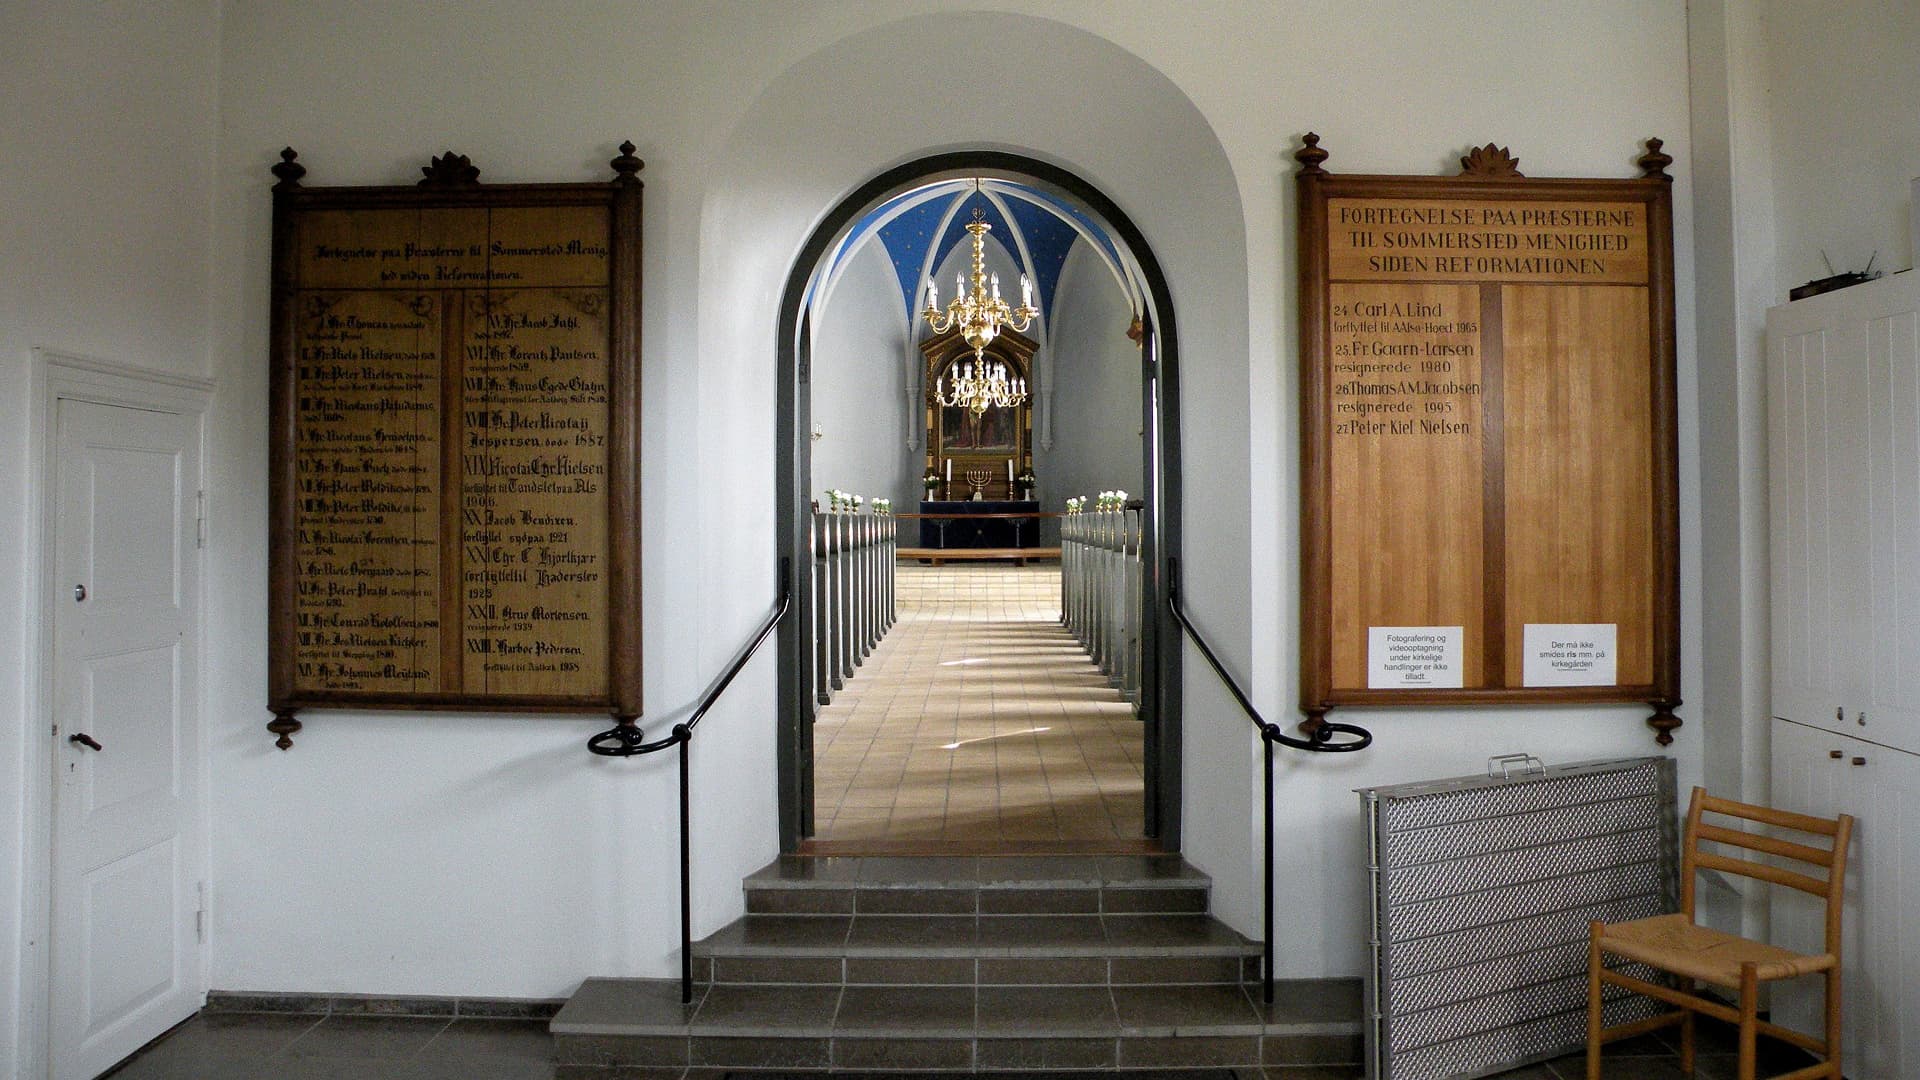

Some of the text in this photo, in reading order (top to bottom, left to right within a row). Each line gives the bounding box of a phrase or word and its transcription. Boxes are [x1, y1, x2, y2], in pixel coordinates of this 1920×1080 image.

[1340, 207, 1635, 228] FORTEGNELSE PAA PRÆSTERNE
[491, 241, 564, 257] Sommersted
[1348, 231, 1629, 251] TIL SOMMERSTED MENIGHED
[1368, 255, 1607, 274] SIDEN REFORMATIONEN
[1354, 301, 1387, 318] Carl
[1406, 301, 1442, 318] Lind
[1333, 321, 1378, 338] forflyttet
[1380, 321, 1390, 333] til
[1455, 321, 1478, 334] 1965
[1371, 341, 1474, 357] Gaarn-Larsen
[1334, 360, 1452, 377] resignerede 1980
[1349, 380, 1397, 396] Thomas
[1421, 380, 1481, 396] Jacobsen
[1336, 400, 1453, 418] resignerede 1995
[1350, 419, 1387, 436] Peter
[1390, 419, 1415, 436] Kiel
[1419, 419, 1471, 436] Nielsen
[548, 531, 569, 544] 1921
[535, 568, 599, 587] Haderslev
[1386, 634, 1447, 644] Fotografering og
[1551, 640, 1594, 649] Der må ikke
[1388, 644, 1445, 653] videooptagning
[1595, 650, 1605, 659] på
[1389, 653, 1443, 662] under kirkelige
[1551, 660, 1593, 669] kirkegården
[1384, 663, 1423, 672] handlinger
[1432, 663, 1448, 671] ikke
